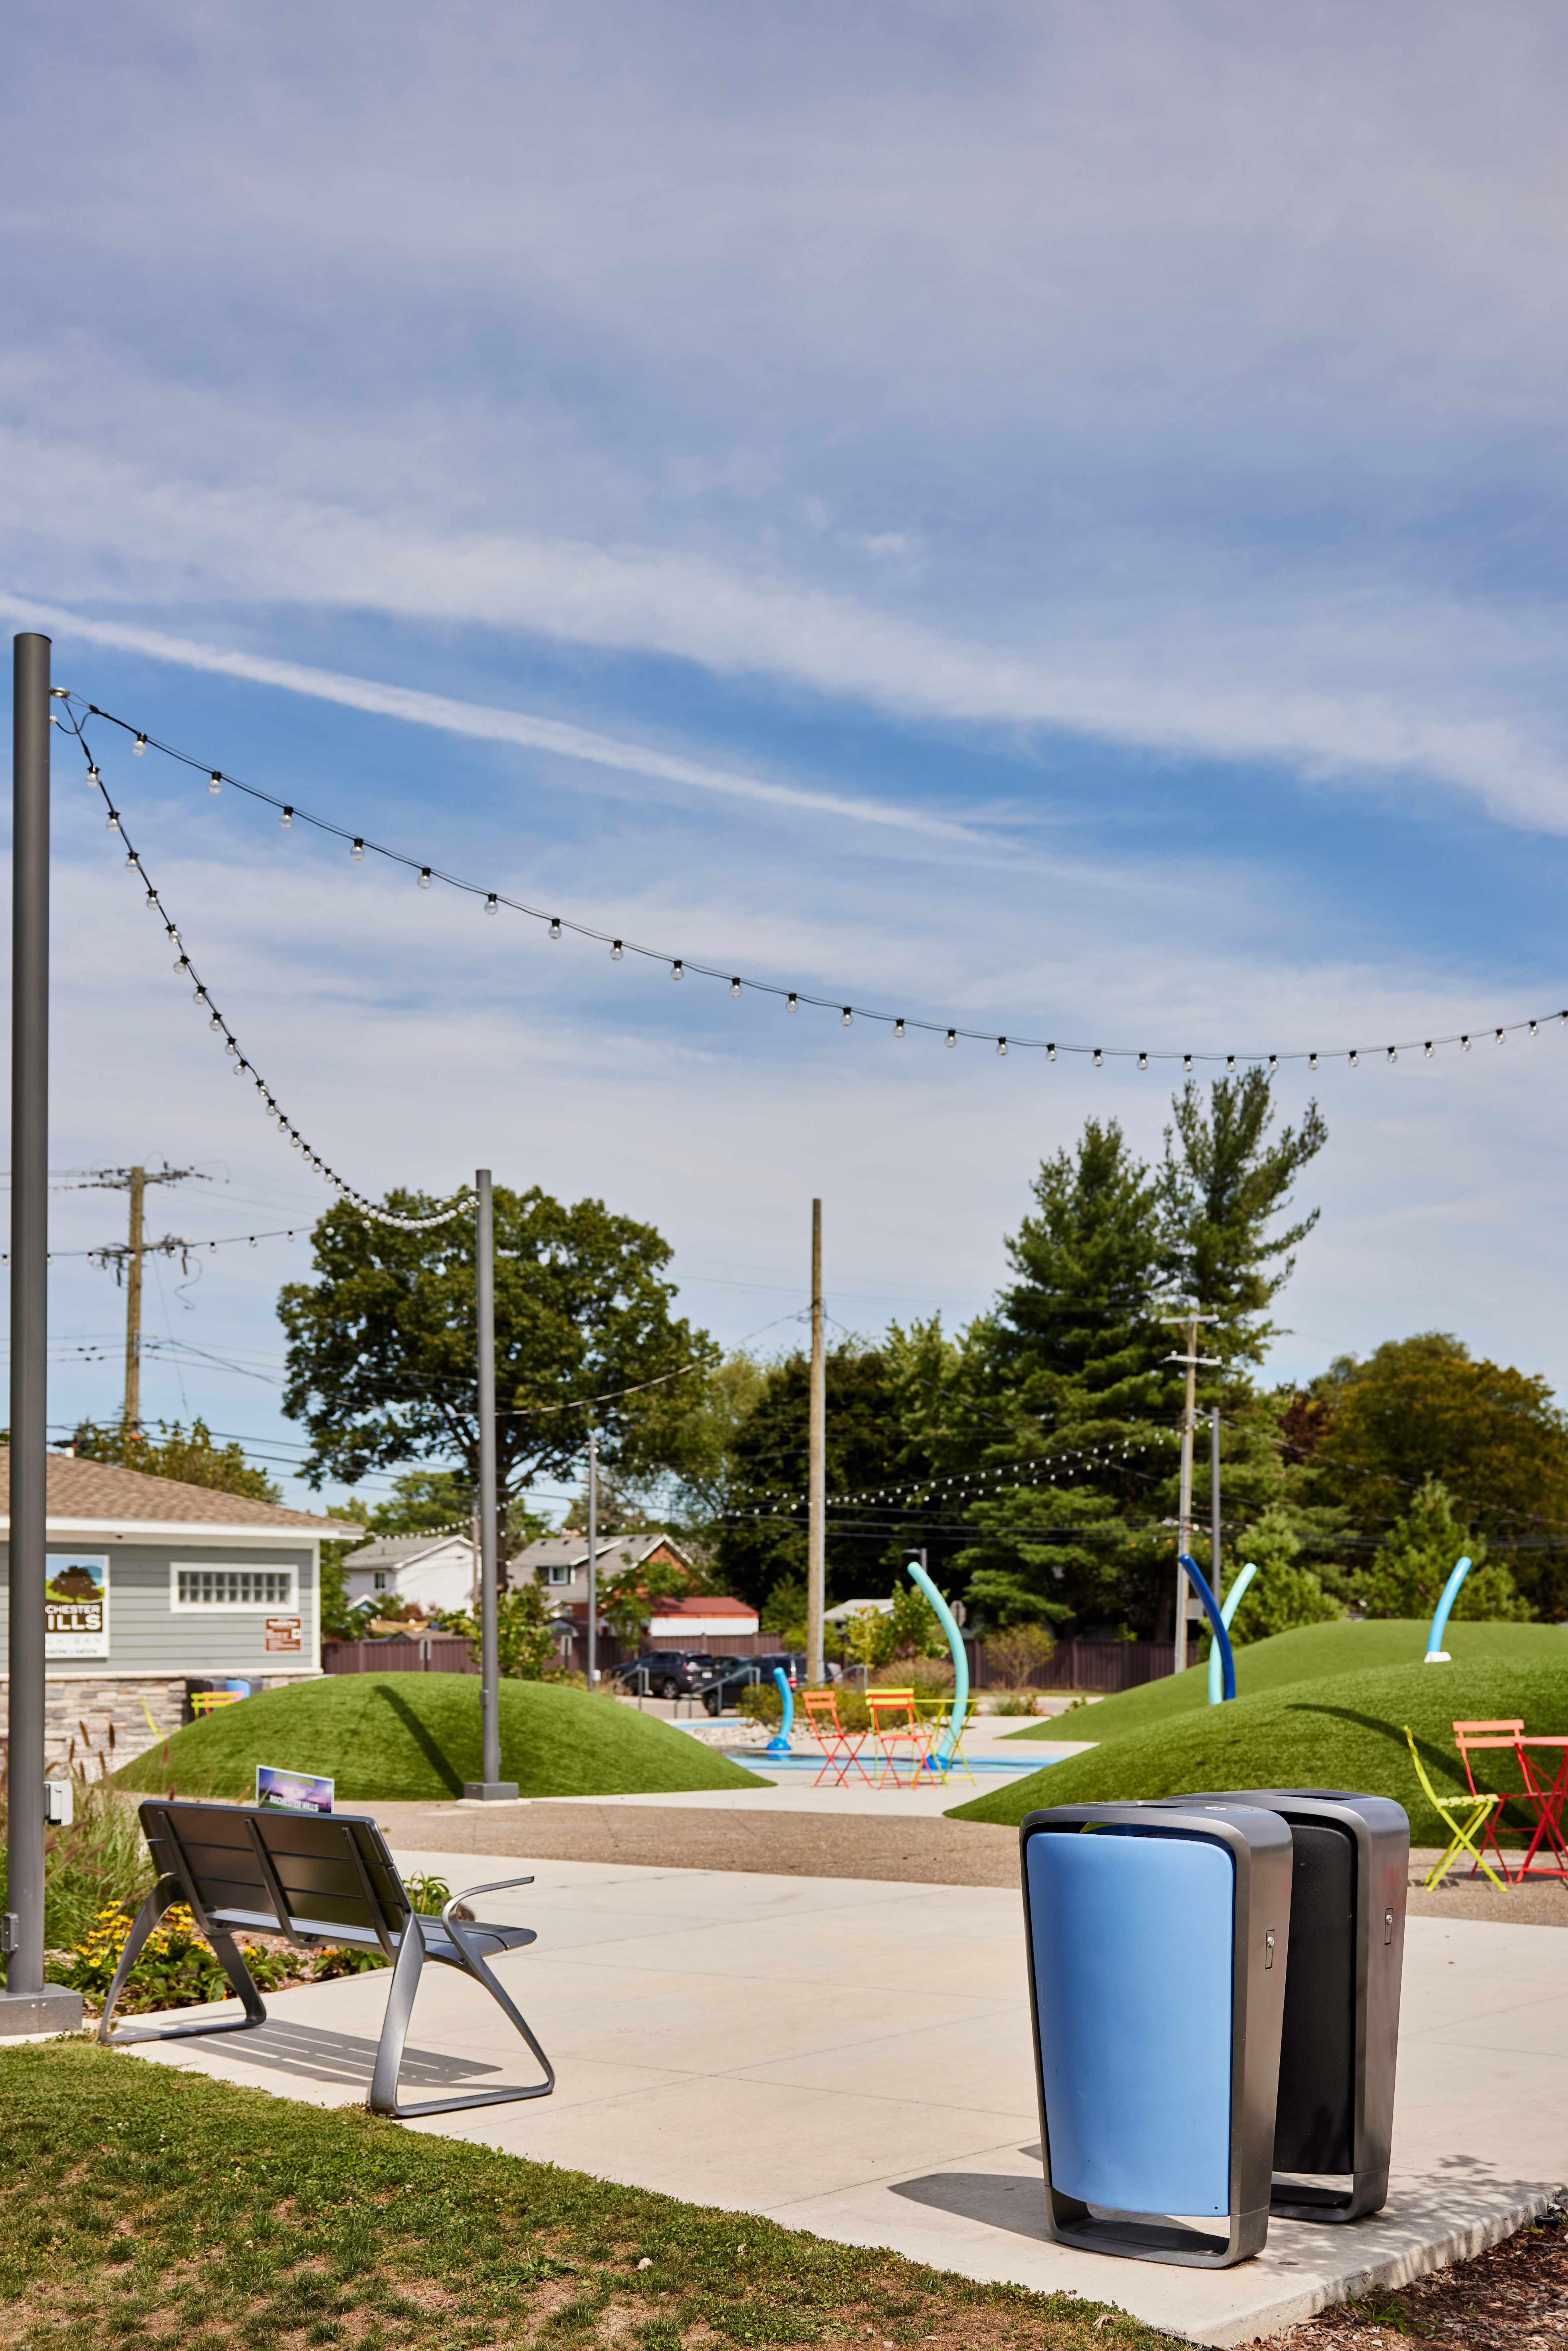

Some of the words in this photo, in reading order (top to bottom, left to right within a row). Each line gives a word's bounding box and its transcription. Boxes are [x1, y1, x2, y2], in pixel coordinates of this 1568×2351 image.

[45, 1604, 101, 1614] CHESTER
[48, 1614, 101, 1630] ILLS
[270, 1795, 301, 1809] ROCHESTER
[301, 1801, 319, 1812] HILLS
